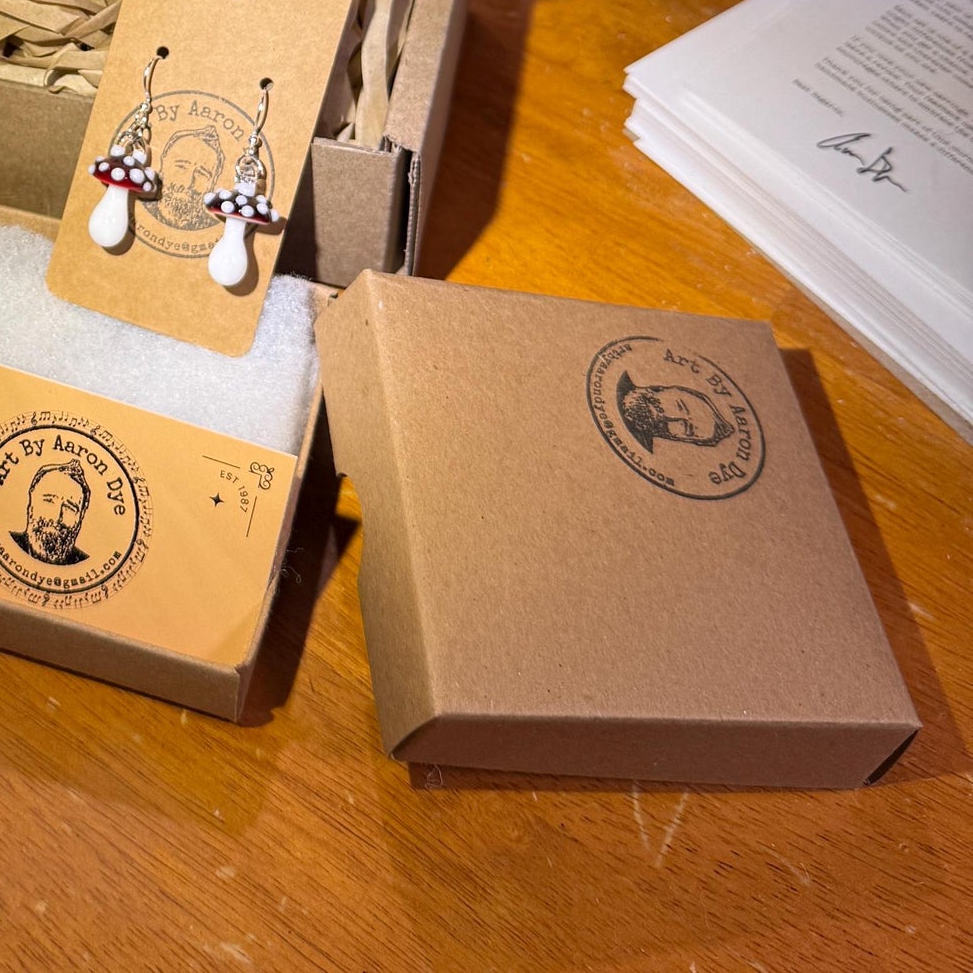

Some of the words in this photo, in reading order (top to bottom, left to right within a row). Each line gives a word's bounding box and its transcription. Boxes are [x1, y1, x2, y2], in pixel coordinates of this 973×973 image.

[154, 104, 180, 122] By
[188, 100, 245, 142] Aaron
[663, 348, 700, 374] Art
[706, 374, 732, 398] By
[593, 343, 675, 487] artbyaarondye@gmail.com
[729, 404, 752, 461] Aaron
[19, 438, 45, 456] By
[52, 434, 108, 476] Aaron
[106, 477, 126, 515] Dye
[220, 469, 239, 484] EST
[238, 485, 249, 513] 1987
[708, 462, 747, 485] Dye
